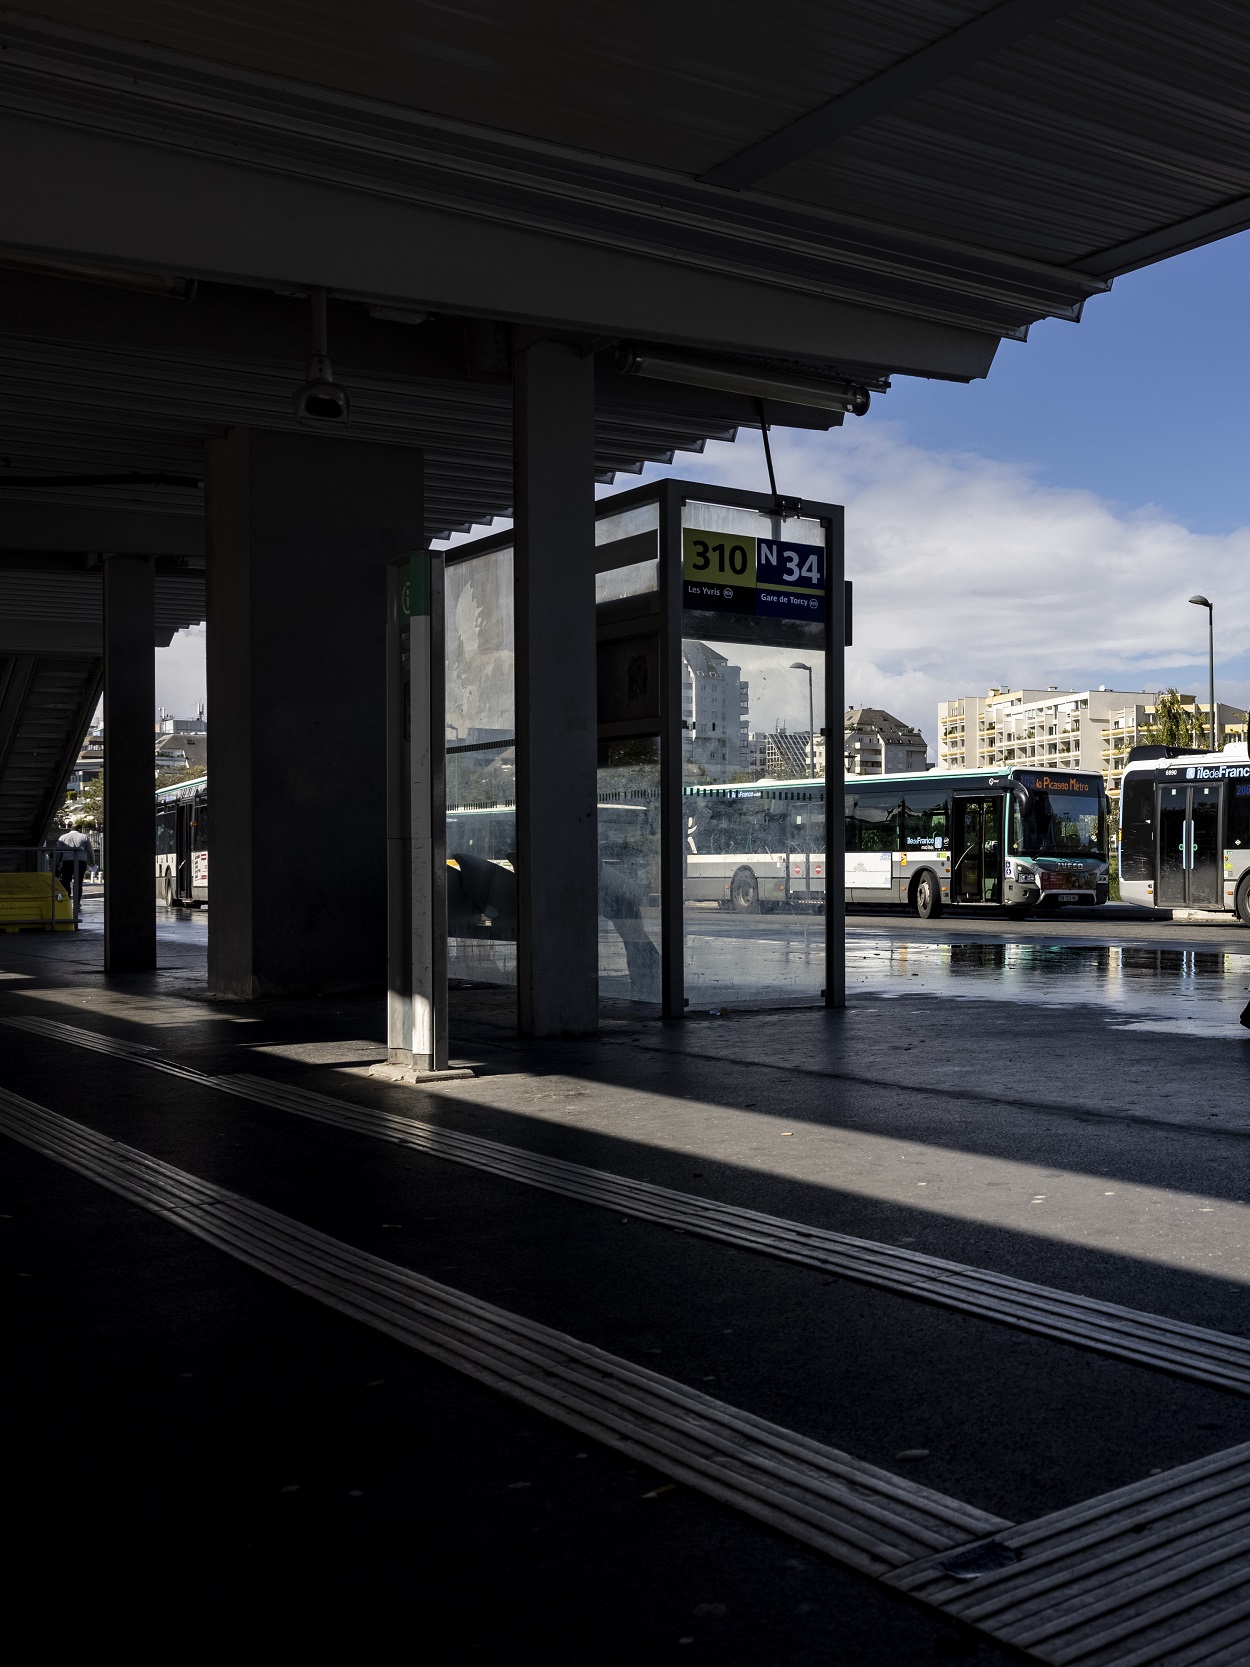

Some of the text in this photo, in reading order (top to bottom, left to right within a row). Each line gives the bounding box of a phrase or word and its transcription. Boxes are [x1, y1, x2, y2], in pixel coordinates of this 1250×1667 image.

[693, 540, 748, 575] 310
[688, 585, 701, 594] Les
[702, 587, 721, 596] Yvris
[761, 593, 778, 602] Gare
[779, 595, 788, 603] de
[789, 596, 808, 606] Torcy
[1043, 777, 1069, 790] Picasso
[1069, 778, 1089, 792] Métro
[1236, 784, 1250, 796] 206
[1057, 862, 1084, 870] IVECO
